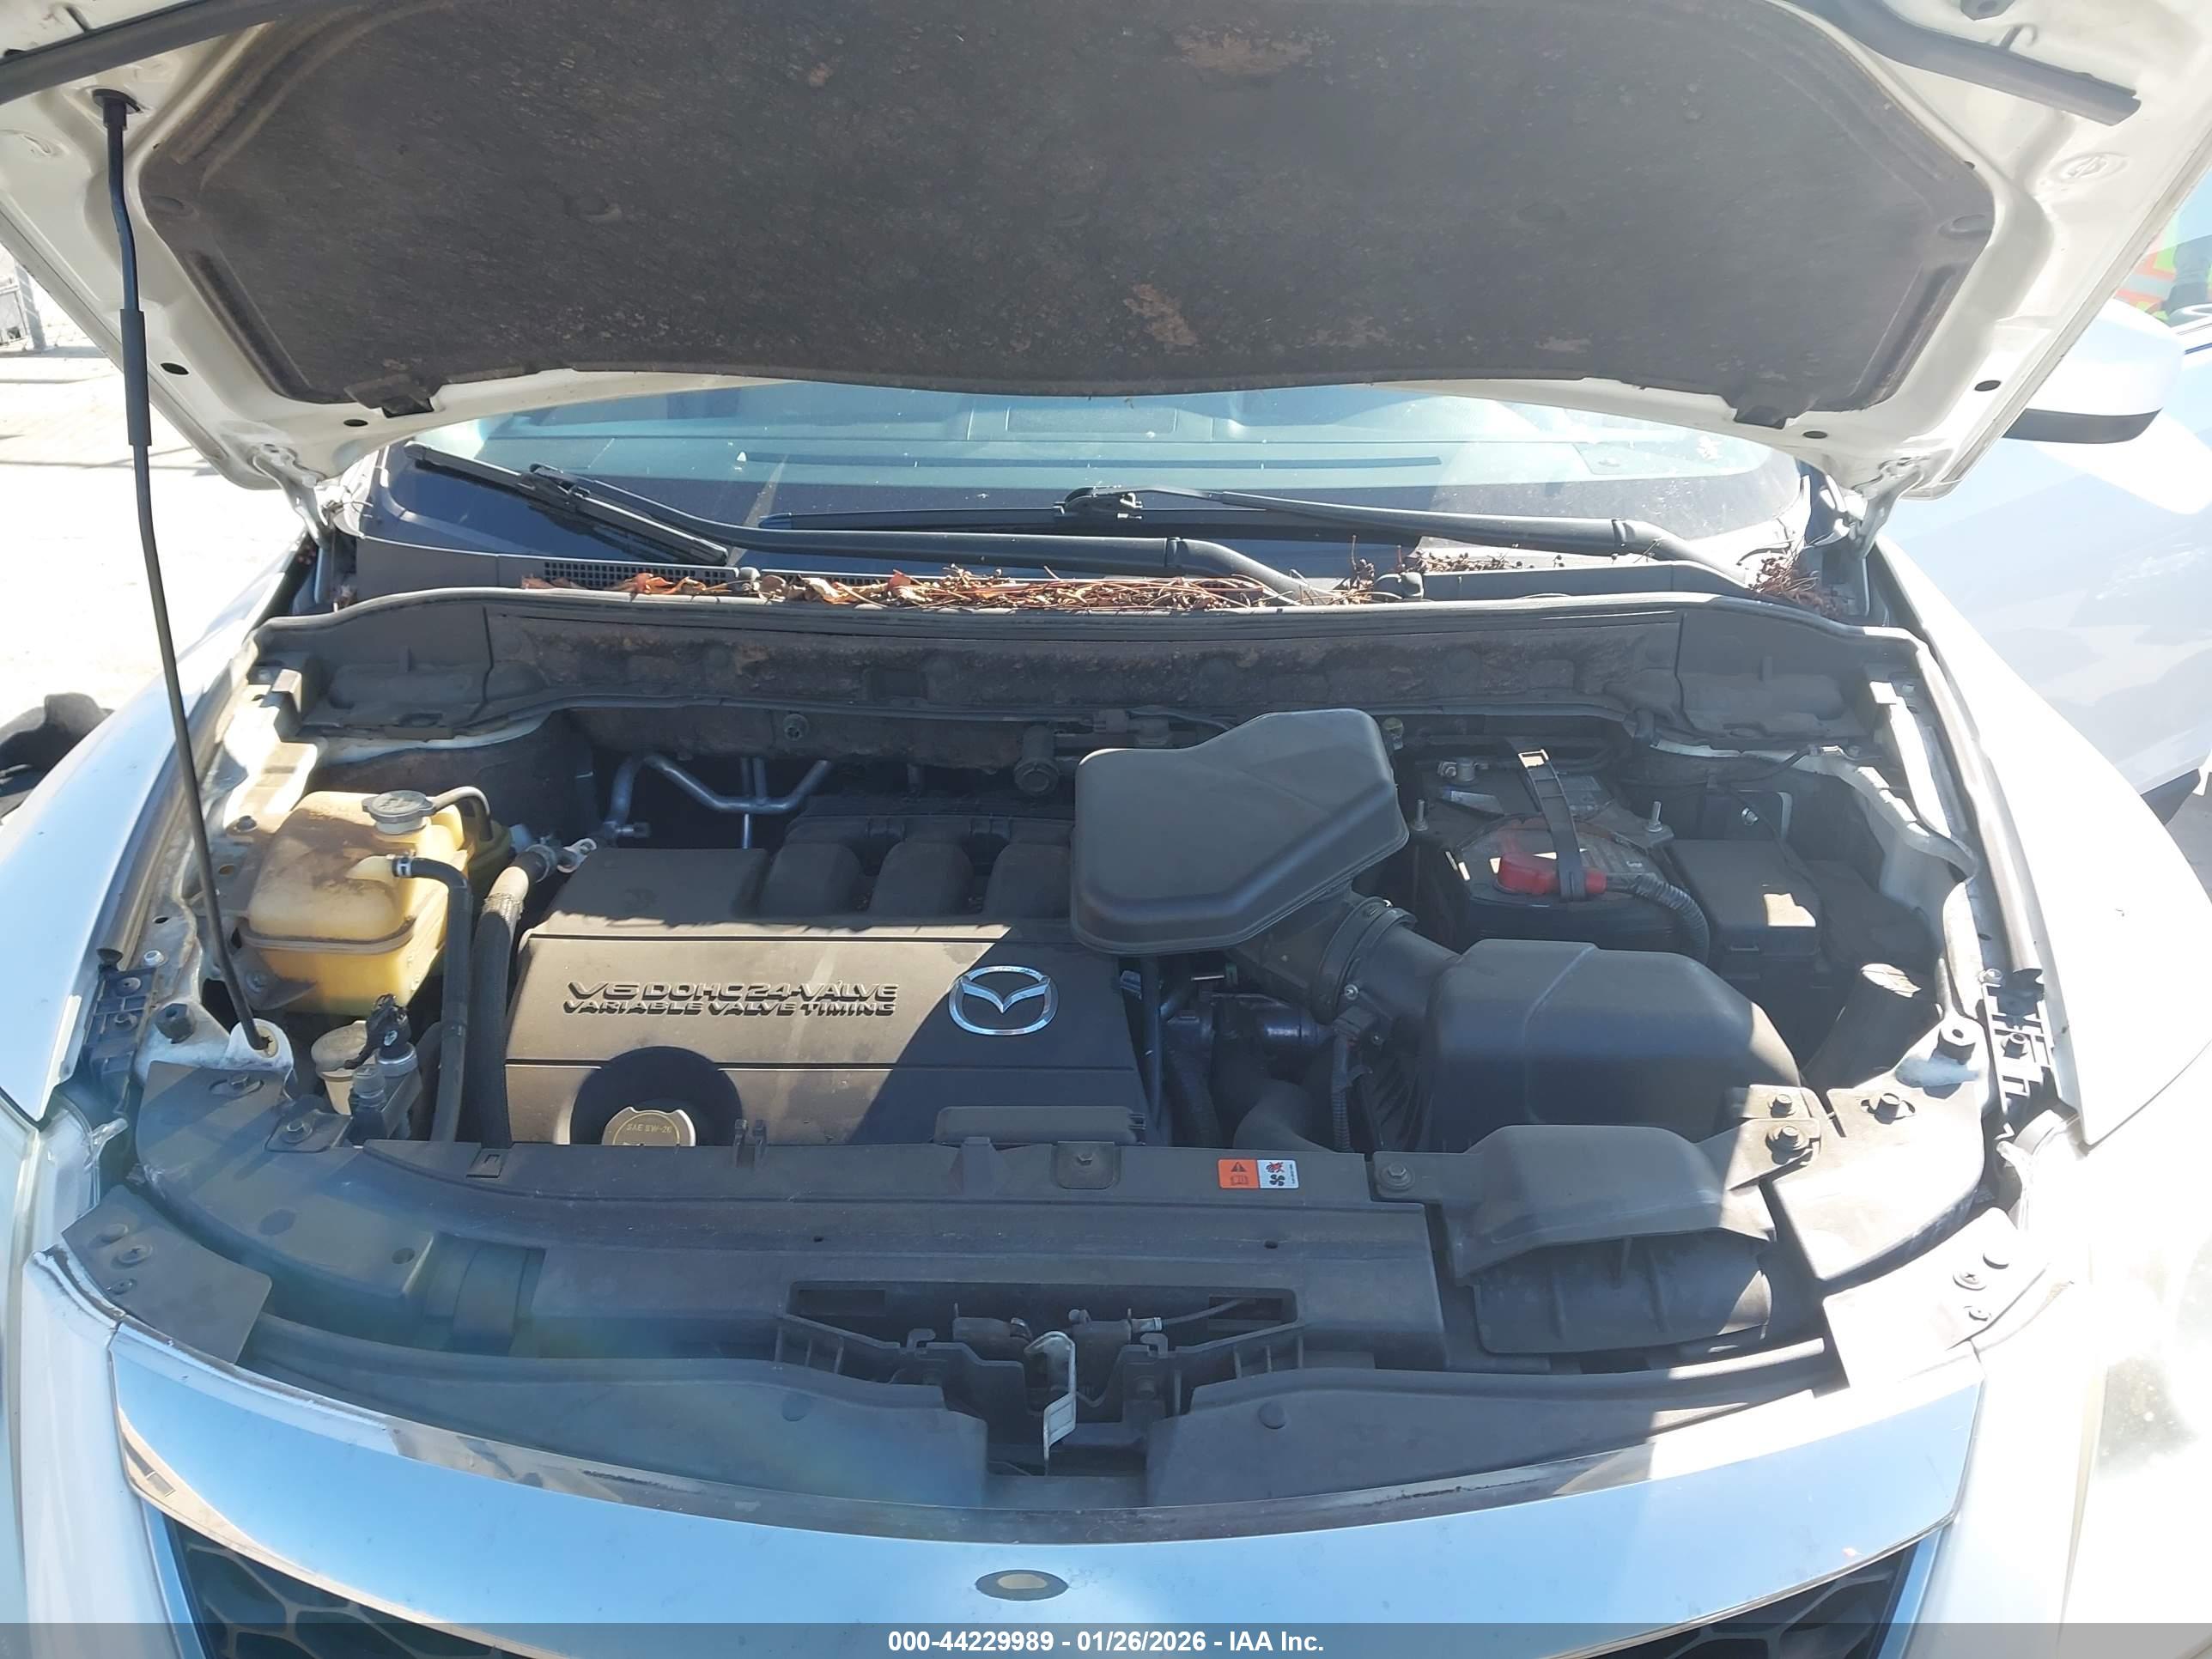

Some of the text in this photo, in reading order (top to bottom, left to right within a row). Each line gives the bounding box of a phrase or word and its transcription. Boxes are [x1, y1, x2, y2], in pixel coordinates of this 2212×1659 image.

[567, 981, 640, 1000] V6
[562, 1000, 897, 1017] VARIABLE VALVE TIMING
[626, 1123, 644, 1133] SAE
